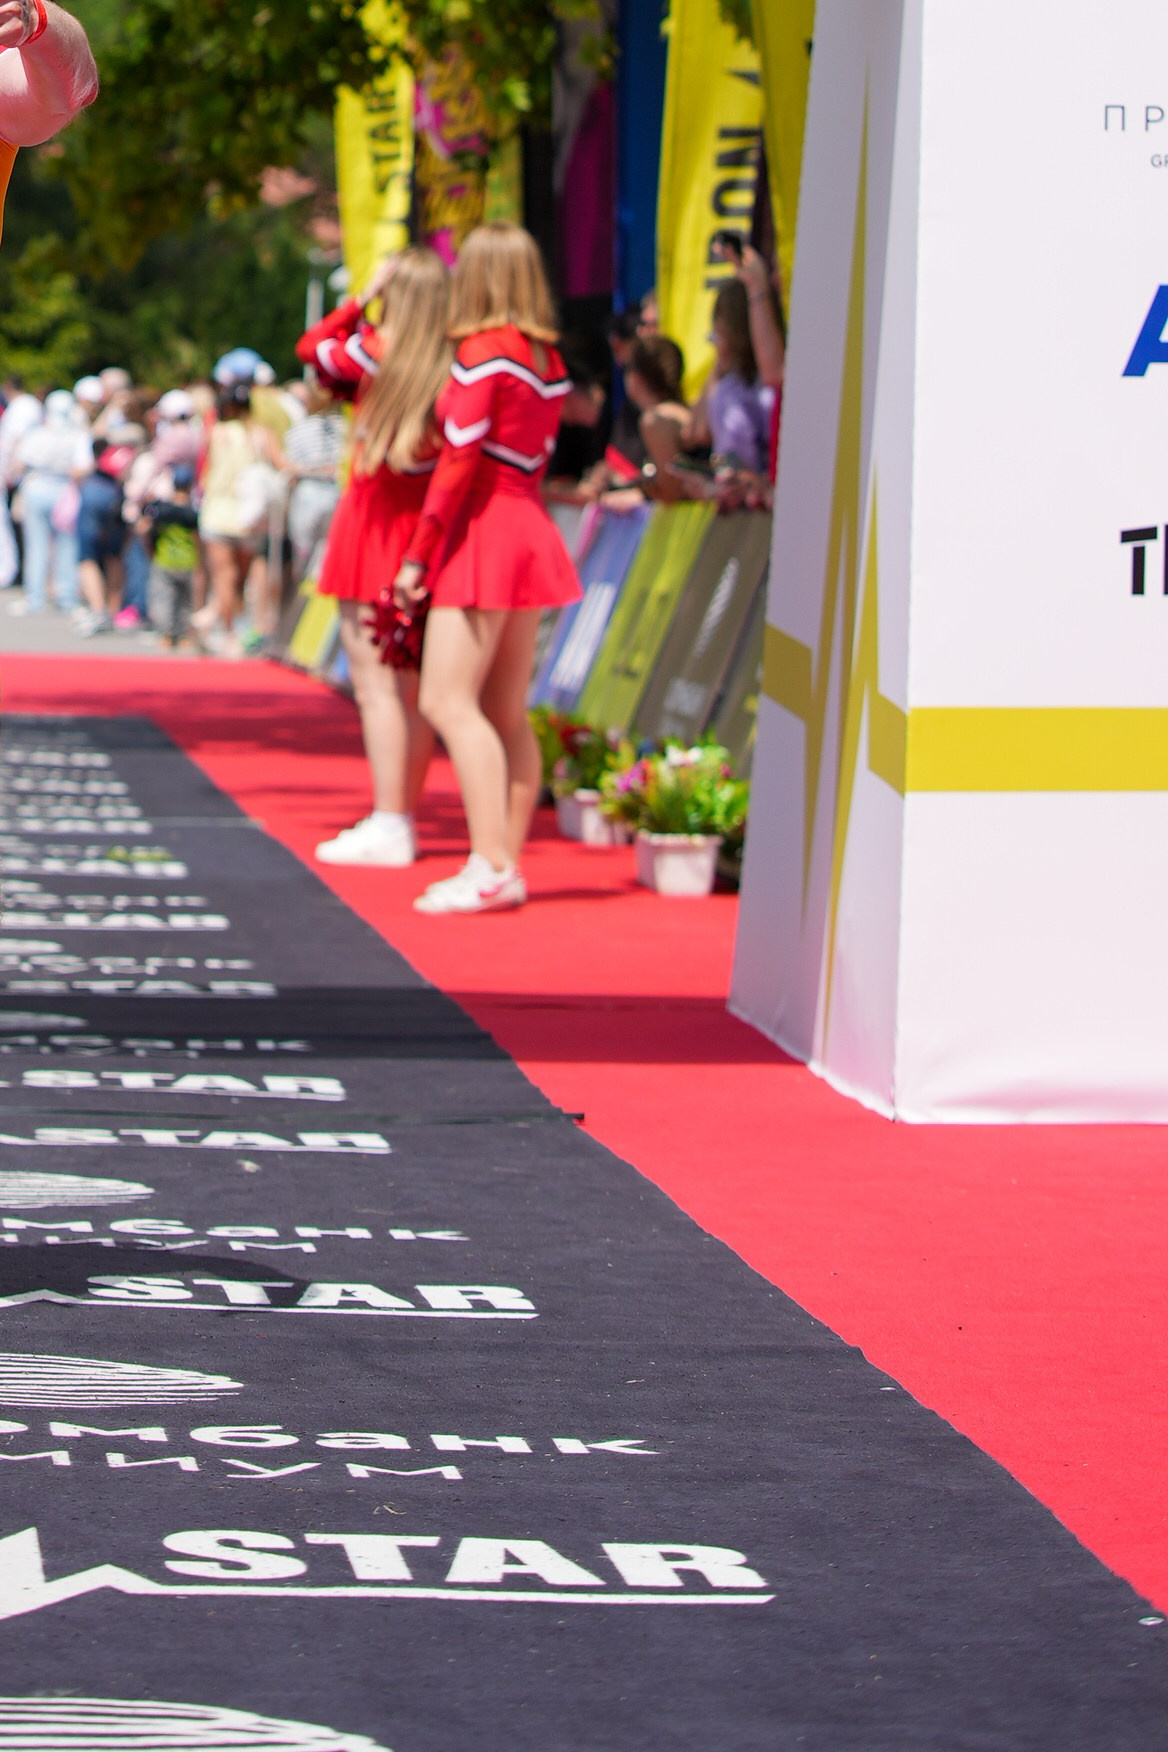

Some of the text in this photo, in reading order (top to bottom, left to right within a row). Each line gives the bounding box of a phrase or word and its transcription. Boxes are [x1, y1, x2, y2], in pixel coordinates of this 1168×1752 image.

[21, 1069, 347, 1098] STAR
[34, 1127, 391, 1149] STAR
[86, 1274, 535, 1311] STAR
[162, 1529, 770, 1588] STAR
